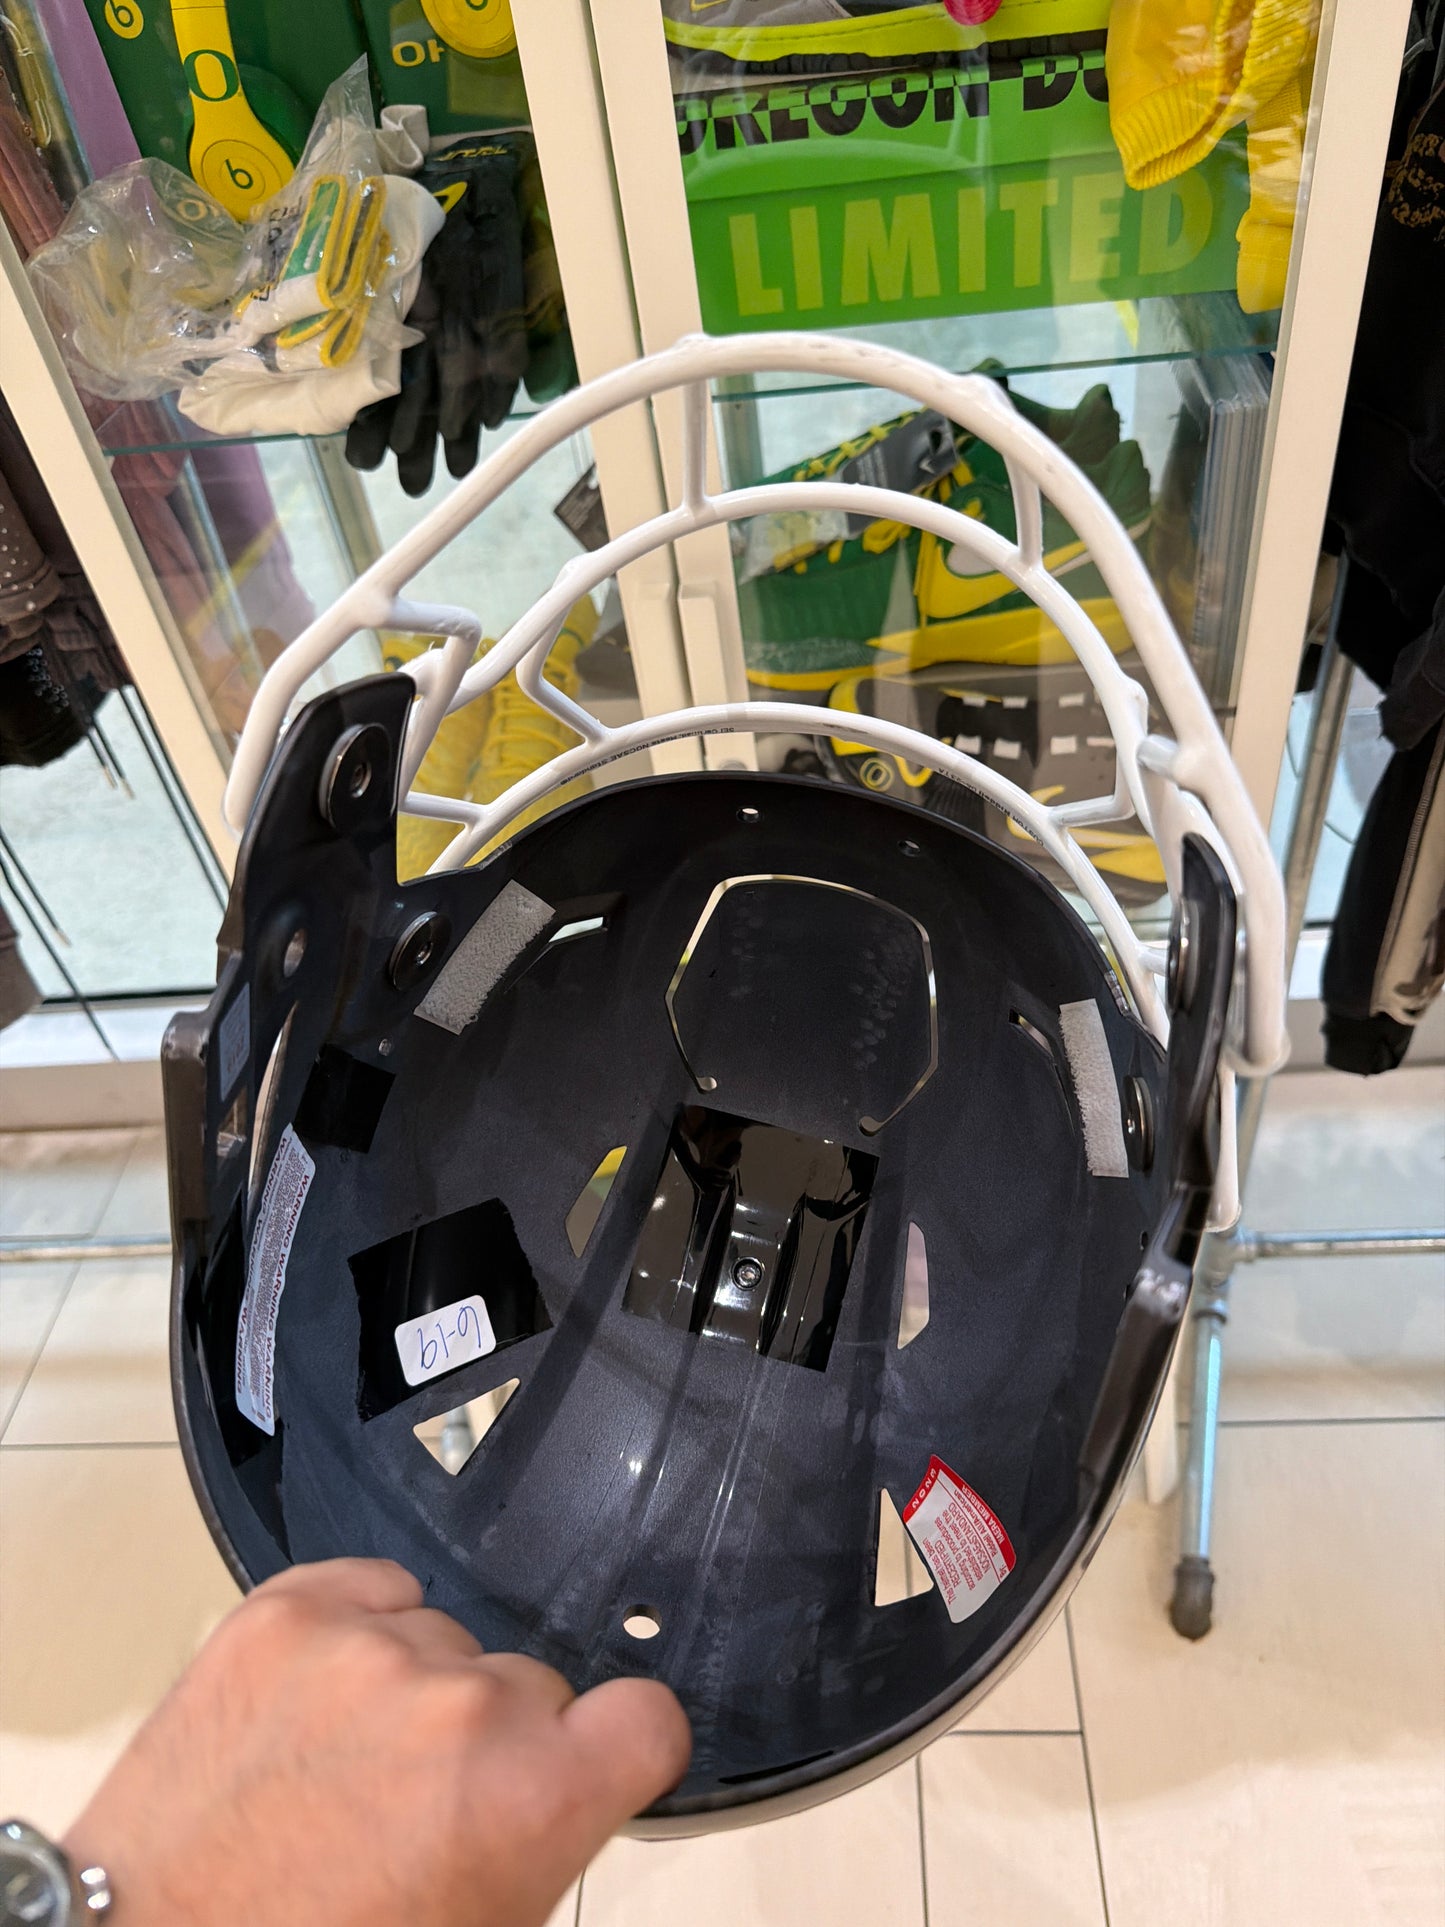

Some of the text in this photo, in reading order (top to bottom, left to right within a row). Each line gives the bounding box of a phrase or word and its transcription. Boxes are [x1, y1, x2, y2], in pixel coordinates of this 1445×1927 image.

[184, 49, 240, 102] O
[729, 168, 1213, 317] LIMITED
[609, 743, 649, 761] NOCSAE
[1011, 814, 1044, 846] CUSTOM
[282, 1174, 310, 1248] WARNING
[236, 1138, 287, 1394] WARNING WARNING WARNING
[267, 1253, 286, 1331] WARNING
[417, 1305, 482, 1370] 6-19
[941, 1509, 984, 1581] established to meet the
[960, 1483, 1005, 1544] NAERA MEMBER
[982, 1533, 997, 1557] Riddell
[920, 1536, 957, 1605] This helmet has been
[932, 1538, 962, 1587] RECERTIFIED
[933, 1515, 975, 1590] according to procedures
